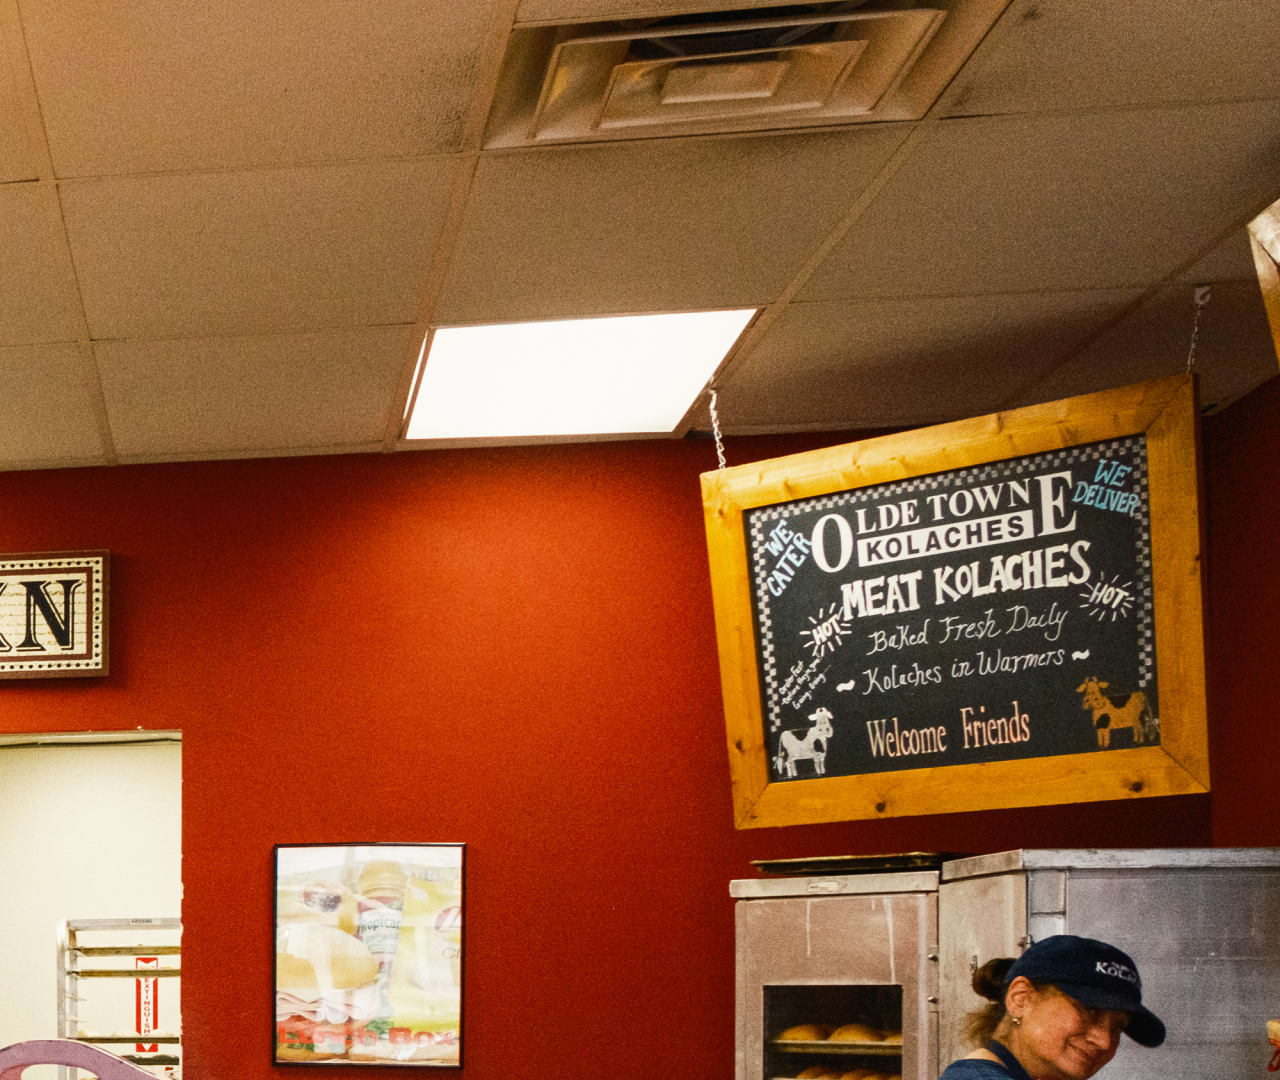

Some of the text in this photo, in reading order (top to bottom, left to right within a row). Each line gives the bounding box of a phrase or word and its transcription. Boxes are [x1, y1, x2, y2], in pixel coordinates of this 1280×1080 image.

[1094, 459, 1132, 487] WE
[1072, 481, 1141, 518] DELIVER
[765, 519, 794, 557] WE
[867, 515, 1025, 562] KOLACHES
[767, 532, 812, 596] CATER
[840, 540, 1091, 621] MEAT KOLACHES
[1090, 582, 1130, 609] HOT
[812, 614, 841, 645] HOT
[939, 608, 1002, 644] Fresh
[1005, 602, 1068, 641] Daily
[862, 649, 1065, 695] Kolaches in Warmers
[866, 701, 1031, 759] Welcome Friends
